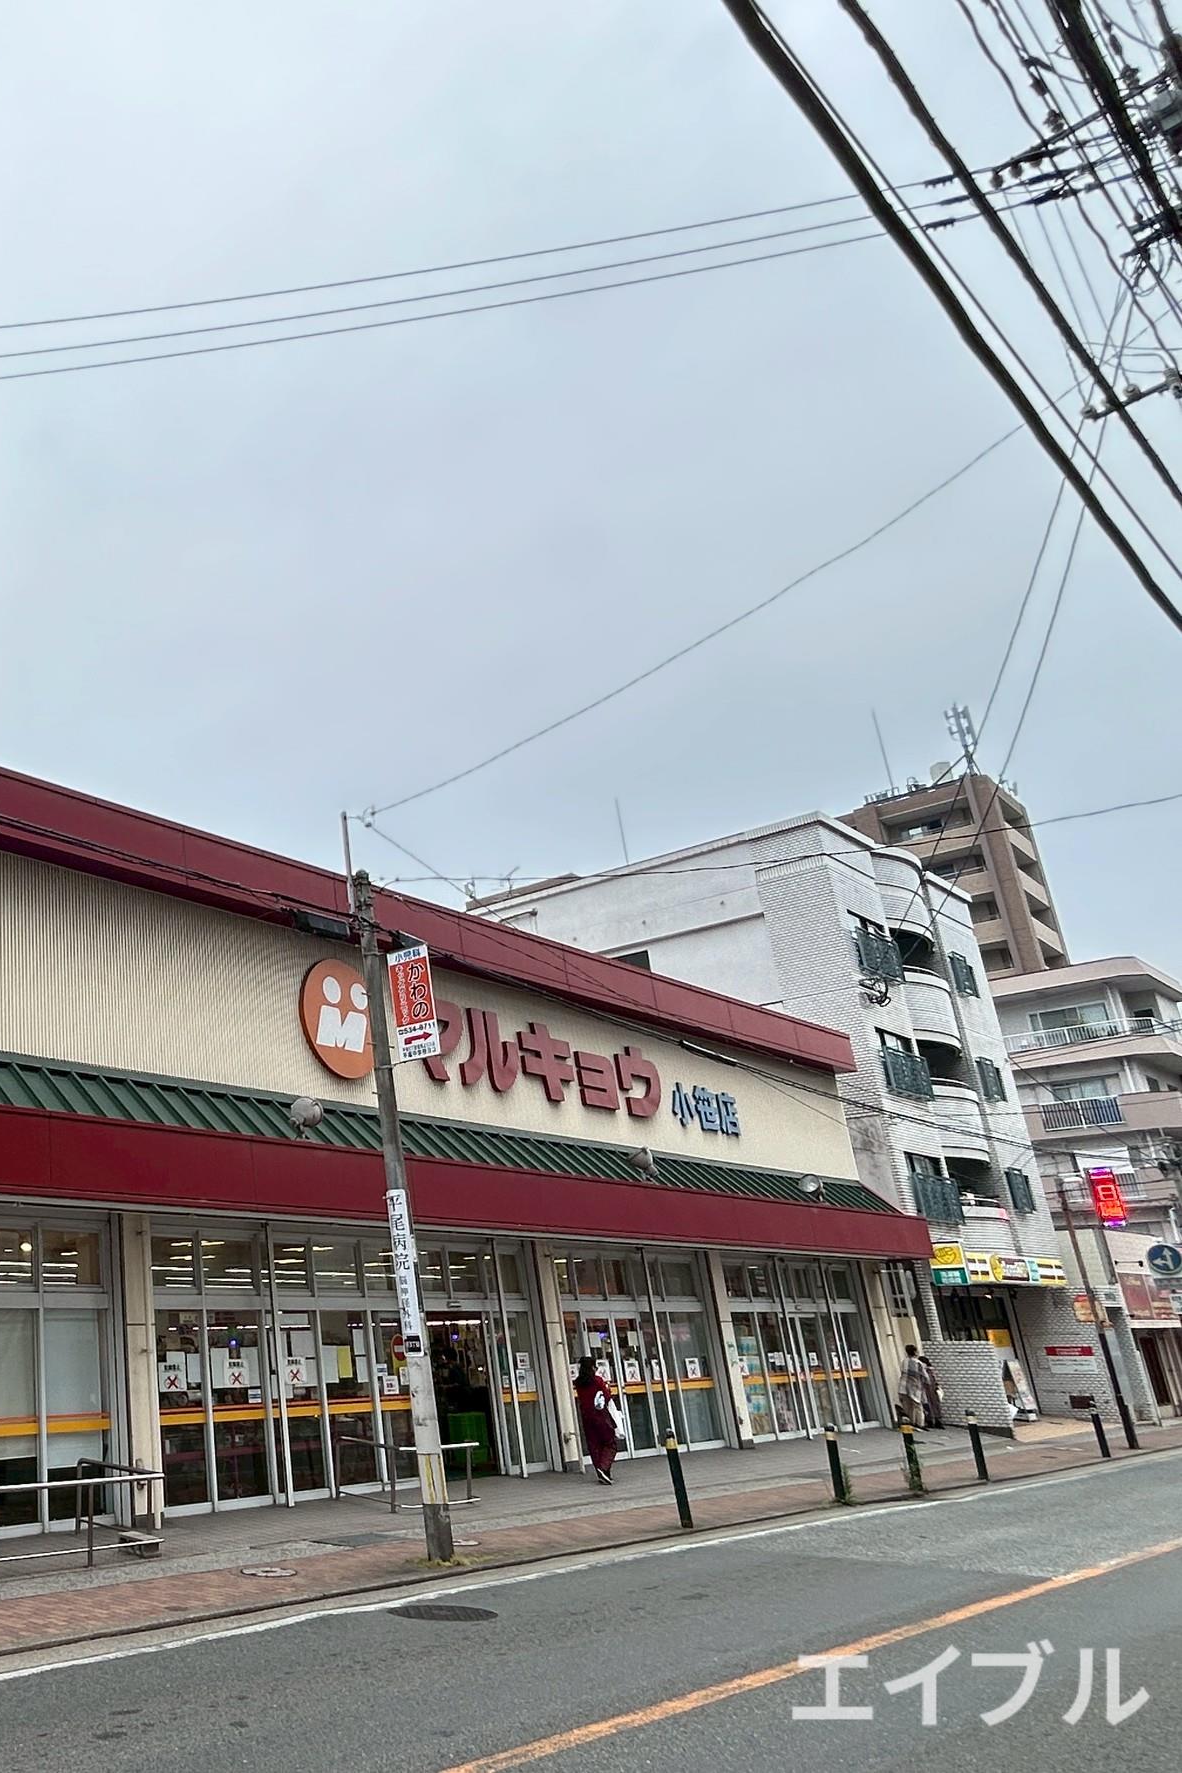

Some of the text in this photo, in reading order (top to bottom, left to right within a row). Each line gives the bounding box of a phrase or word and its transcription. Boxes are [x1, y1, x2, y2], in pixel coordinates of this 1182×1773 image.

[407, 962, 431, 1019] かわの
[423, 999, 742, 1138] マルキョウ 小笹店
[388, 1194, 410, 1271] 平尾病院
